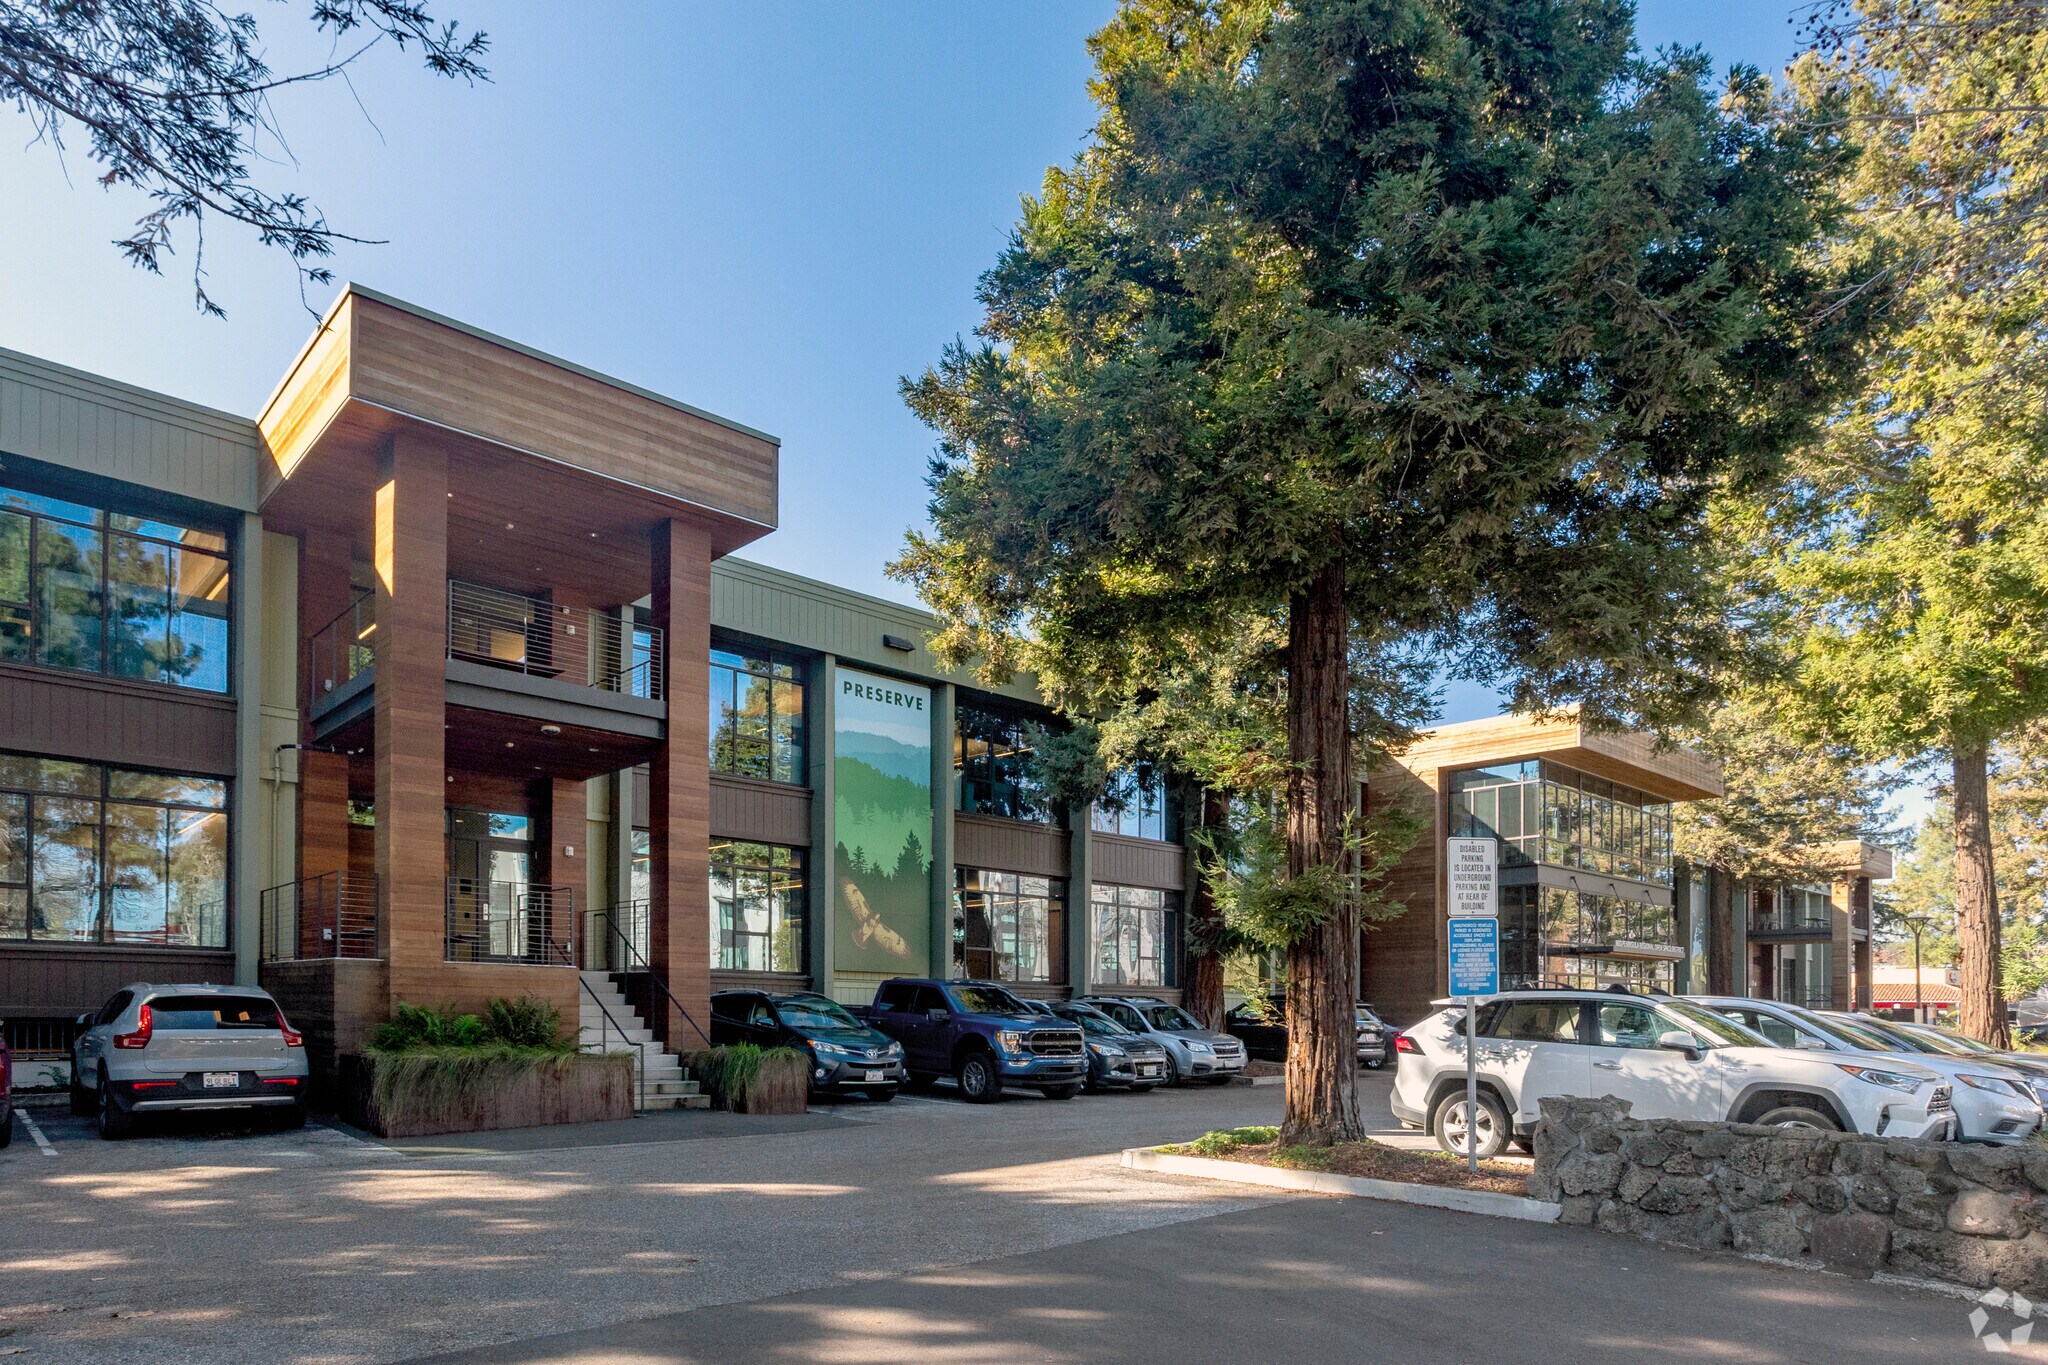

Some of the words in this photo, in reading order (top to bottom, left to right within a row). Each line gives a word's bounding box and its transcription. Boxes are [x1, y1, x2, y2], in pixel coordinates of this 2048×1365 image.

[844, 680, 923, 711] PRESERVE
[1460, 845, 1485, 853] DISABLED
[1454, 864, 1460, 872] IS
[1461, 864, 1484, 872] LOCATED
[1485, 864, 1491, 872] IN
[1454, 873, 1492, 881] UNDERGROUND
[1455, 883, 1478, 891] PARKING
[1479, 883, 1491, 891] AND
[1461, 902, 1485, 910] BUILDING
